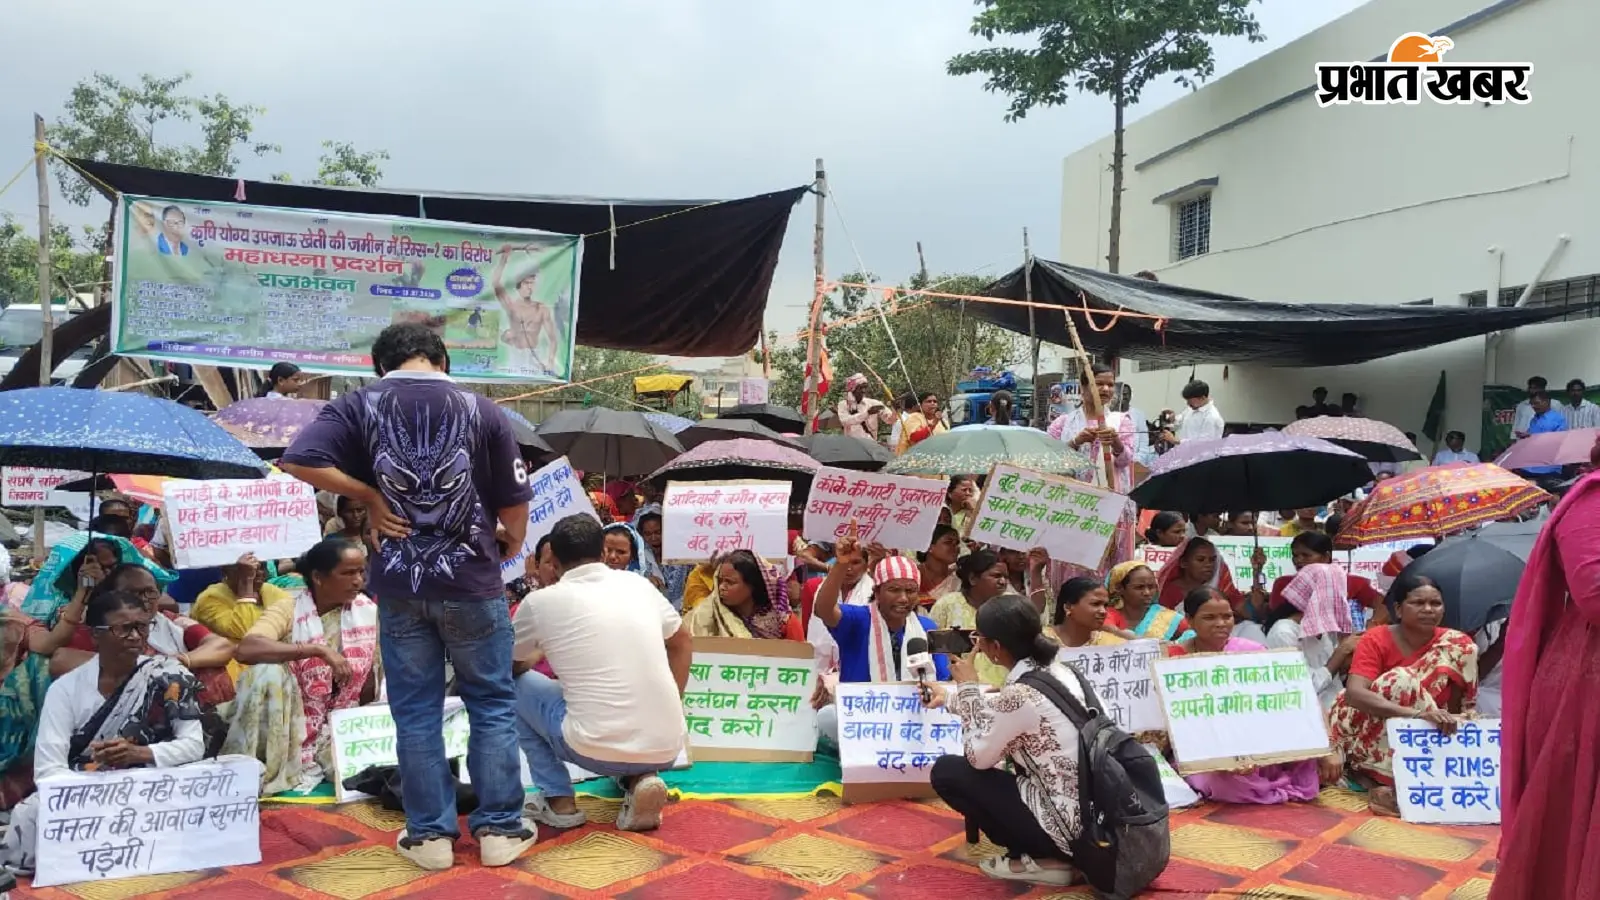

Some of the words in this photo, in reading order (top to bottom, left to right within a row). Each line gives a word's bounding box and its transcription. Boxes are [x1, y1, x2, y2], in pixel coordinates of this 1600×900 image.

[190, 220, 217, 247] कृषि
[219, 222, 249, 243] योग्य
[252, 230, 297, 248] उपजाऊ
[300, 228, 327, 249] खेती
[329, 230, 346, 251] की
[348, 232, 385, 254] जमीन
[443, 245, 458, 261] का
[461, 240, 492, 263] विरोध
[224, 248, 327, 268] महाधरना
[331, 254, 404, 274] प्रदर्शन
[257, 273, 356, 292] राजभवन
[513, 458, 527, 484] 6
[218, 483, 232, 500] के
[848, 480, 869, 499] की
[178, 506, 200, 524] एक
[204, 503, 218, 522] ही
[808, 500, 852, 517] अपनी
[175, 526, 238, 549] अधिकार
[1093, 653, 1105, 674] के
[777, 668, 810, 686] का
[1099, 677, 1119, 699] की
[1123, 678, 1151, 699] रक्षा
[1163, 669, 1208, 692] एकता
[1211, 664, 1230, 687] की
[1232, 665, 1269, 684] ताकत
[684, 688, 740, 709] ल्लंघन
[746, 694, 802, 714] करना
[1170, 692, 1214, 718] अपनी
[1216, 690, 1253, 714] जमीन
[843, 722, 892, 741] डालना
[900, 720, 925, 744] बंद
[1456, 723, 1482, 748] की
[1402, 757, 1435, 778] पर
[47, 776, 138, 813] तानाशाही
[1408, 781, 1446, 812] बंद
[44, 815, 106, 843] जनता
[108, 808, 138, 837] की
[140, 806, 206, 833] आवाज
